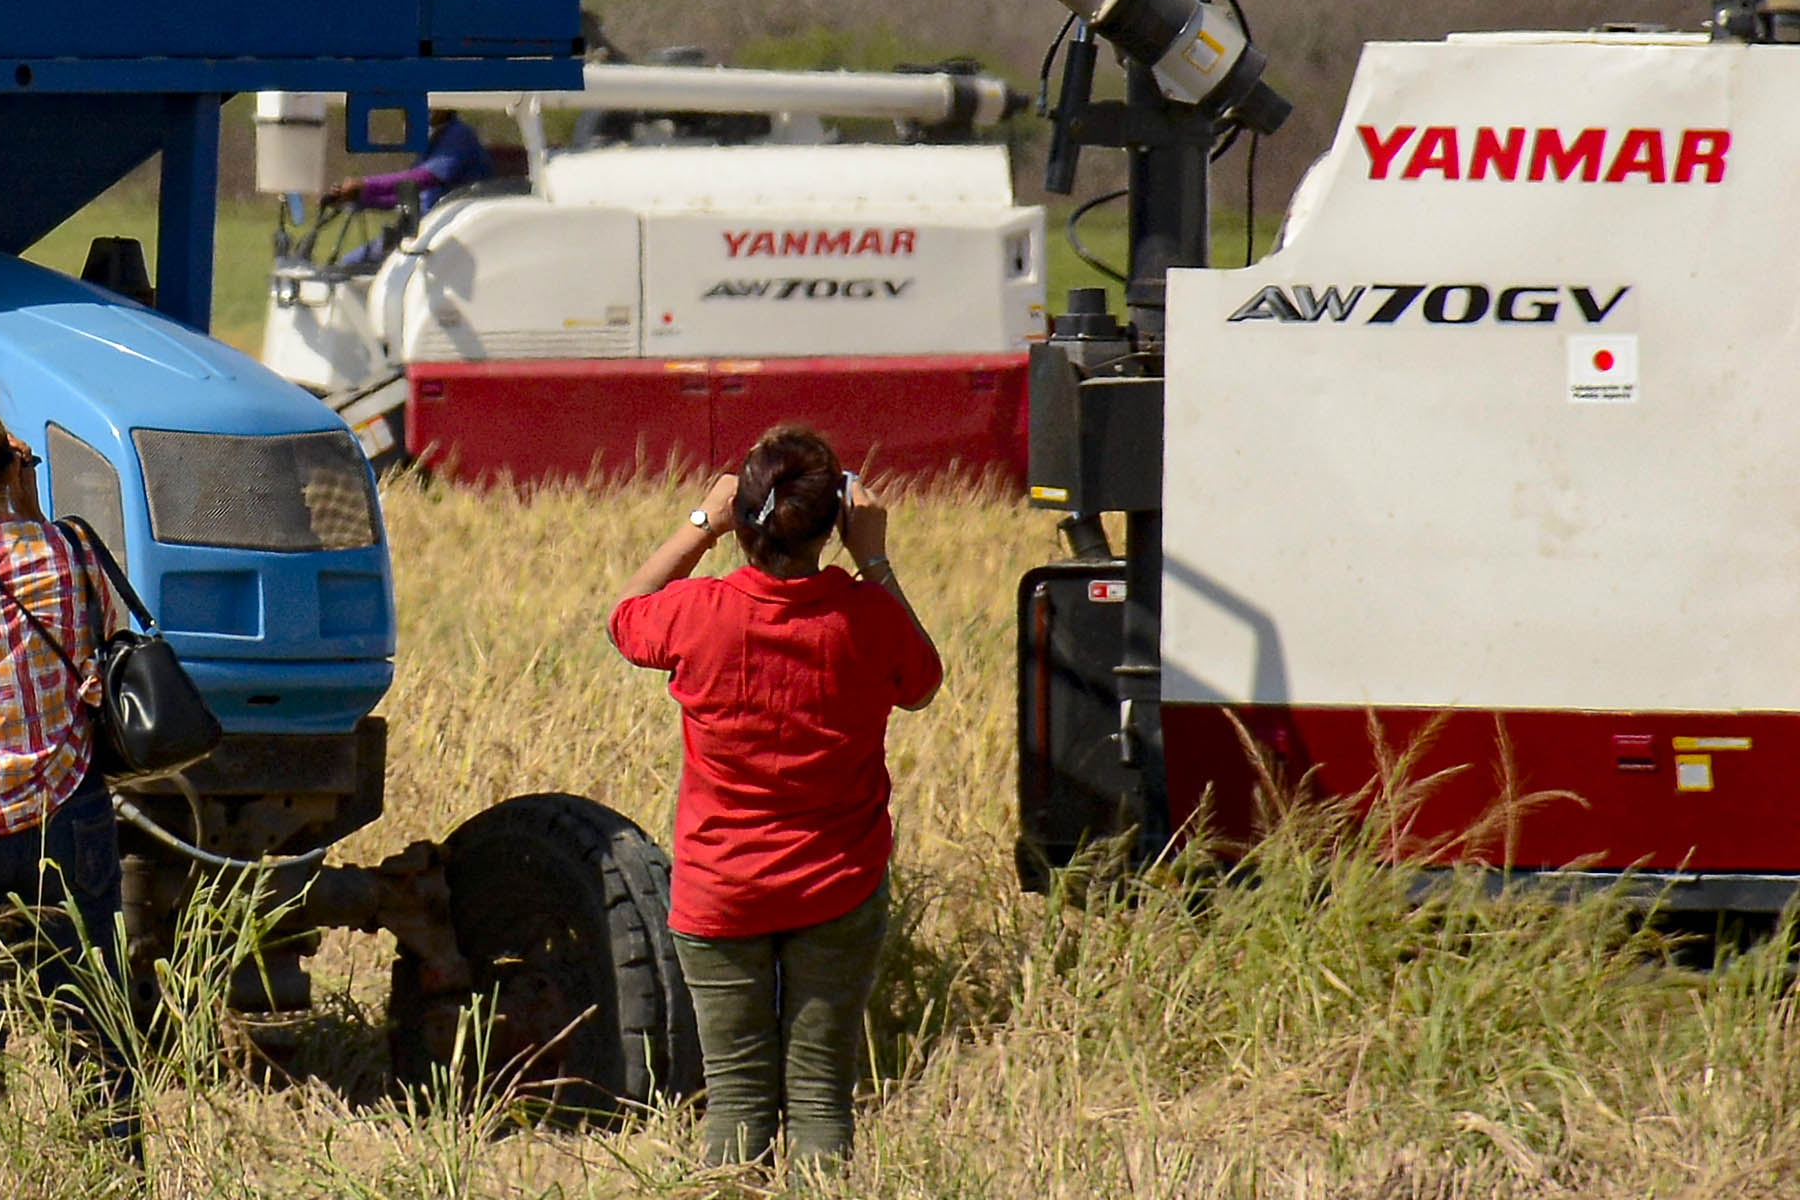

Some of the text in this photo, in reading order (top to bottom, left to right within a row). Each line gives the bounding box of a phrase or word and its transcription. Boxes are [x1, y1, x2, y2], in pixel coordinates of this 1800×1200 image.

[1356, 124, 1732, 184] YANMAR
[723, 228, 916, 257] YANMAR
[703, 278, 911, 300] AW70GV
[1226, 283, 1632, 325] AW70GV
